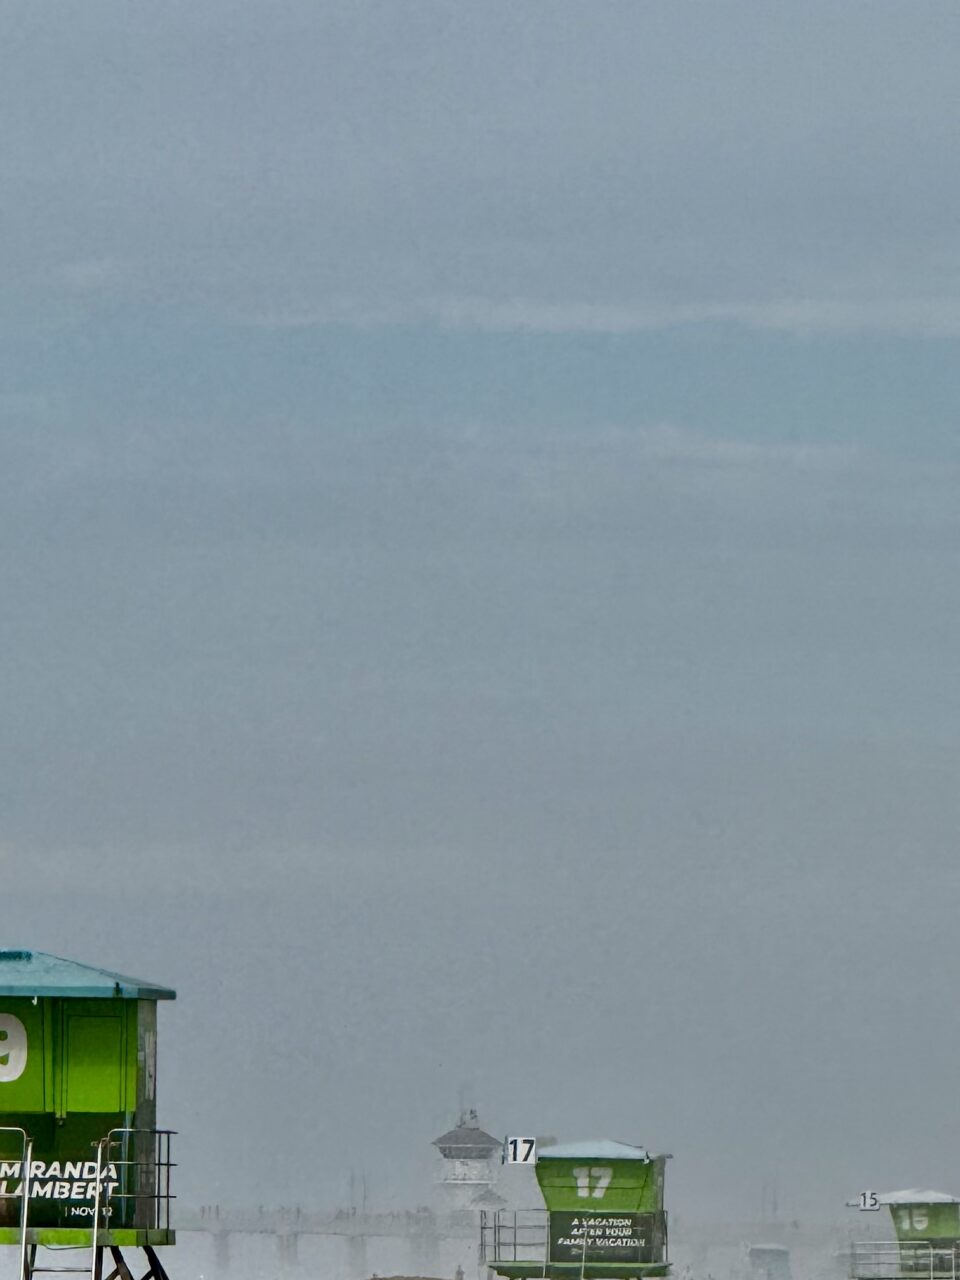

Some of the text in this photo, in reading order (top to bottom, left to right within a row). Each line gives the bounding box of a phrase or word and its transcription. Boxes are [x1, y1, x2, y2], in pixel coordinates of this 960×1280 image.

[508, 1138, 536, 1162] 17
[0, 1160, 118, 1179] MIRANDA
[0, 1180, 120, 1199] LAMBERT
[573, 1167, 613, 1198] 17
[860, 1192, 878, 1207] 15
[71, 1207, 95, 1216] NOV
[571, 1217, 633, 1226] A VACATION
